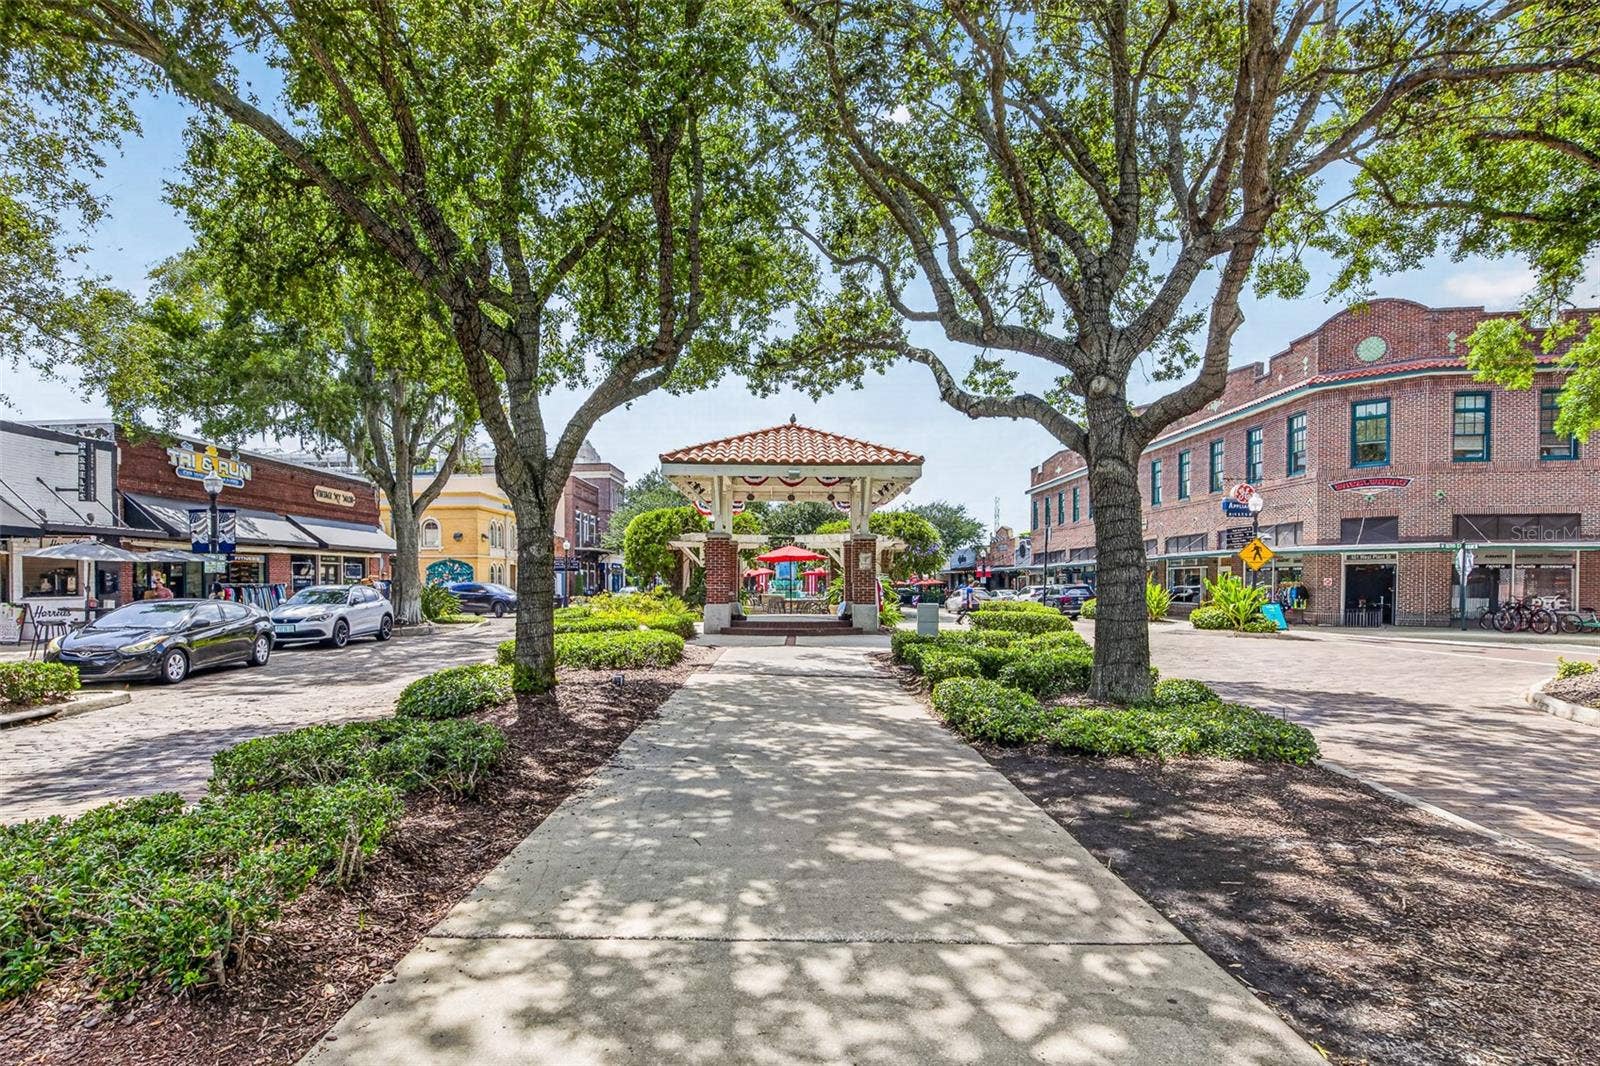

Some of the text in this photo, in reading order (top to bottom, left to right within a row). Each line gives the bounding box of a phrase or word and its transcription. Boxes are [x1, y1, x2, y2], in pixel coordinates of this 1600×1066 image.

[167, 448, 196, 468] TRI
[202, 456, 214, 472] &
[218, 460, 252, 480] RUN
